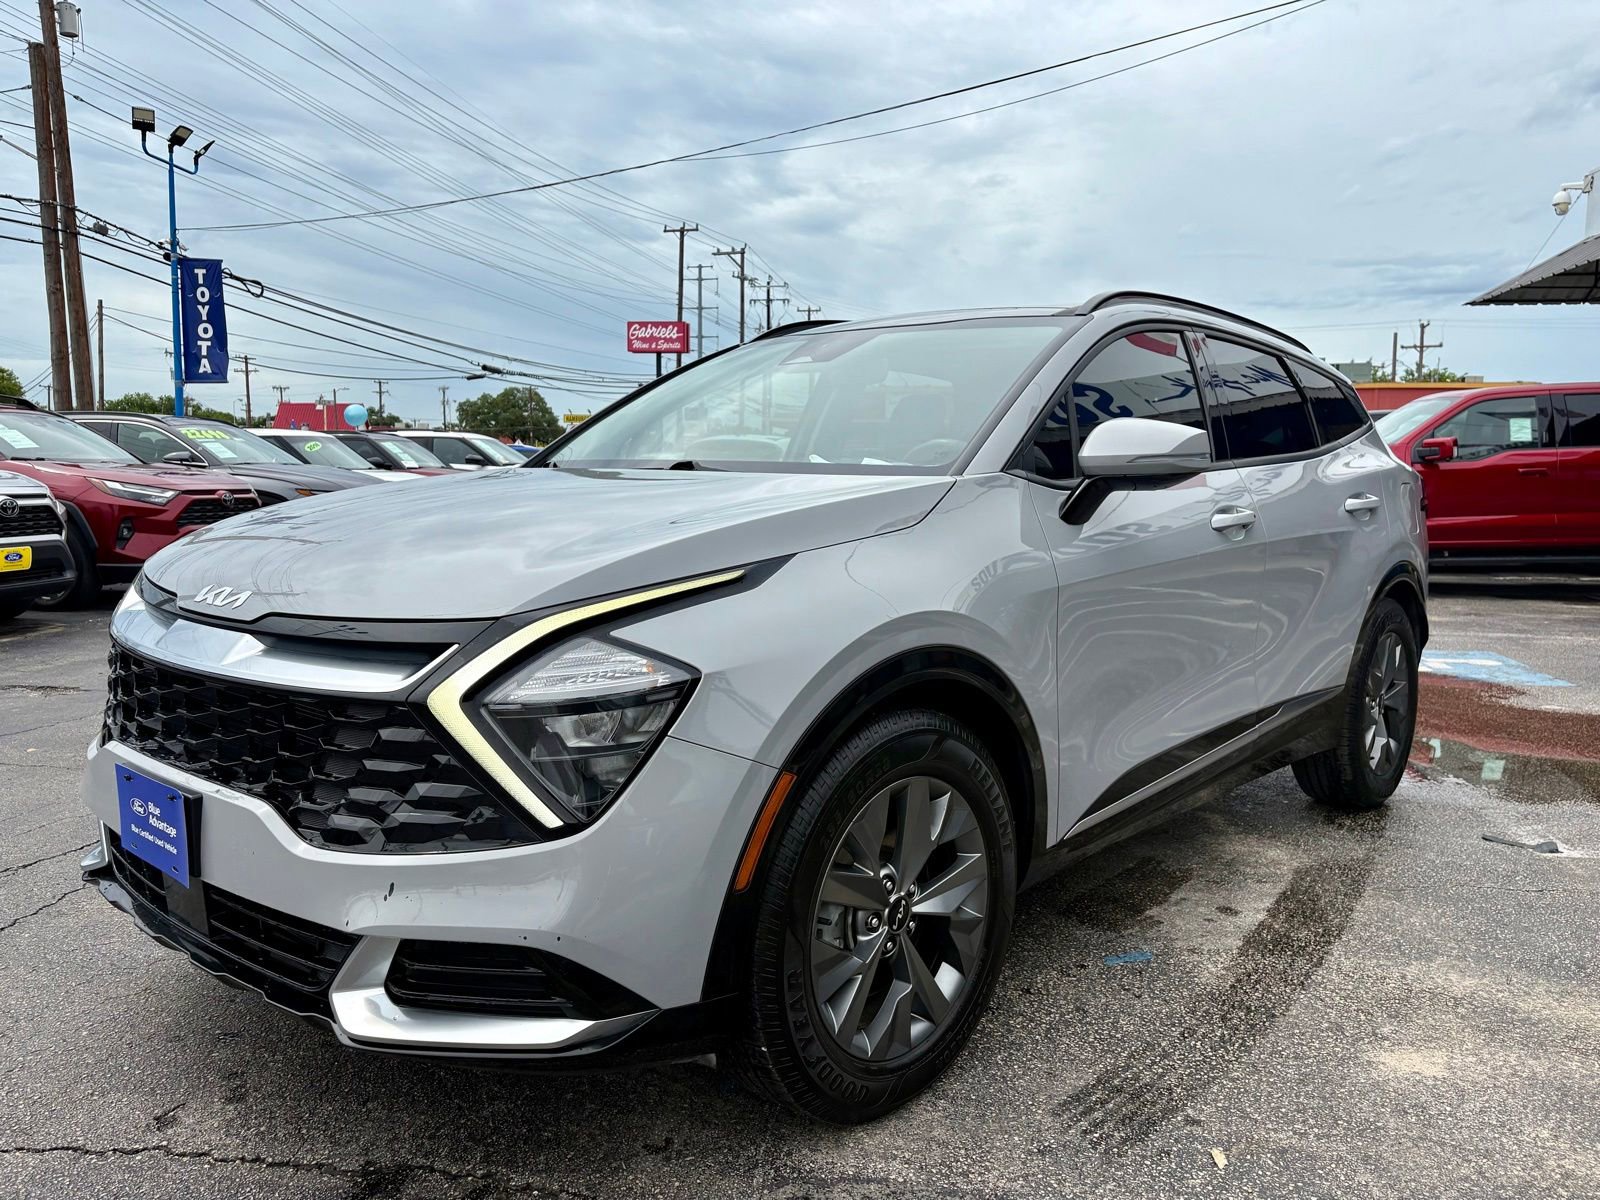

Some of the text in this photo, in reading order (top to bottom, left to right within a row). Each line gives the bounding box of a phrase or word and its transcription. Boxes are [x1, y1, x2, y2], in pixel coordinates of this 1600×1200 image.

[193, 268, 213, 373] TOYOTA
[629, 323, 683, 339] Gabriels
[632, 340, 650, 349] Wine
[657, 340, 681, 350] Spirits
[148, 801, 161, 816] Blue
[148, 814, 177, 838] Advantage
[131, 824, 178, 855] Blue Certified Used Vehicle
[785, 967, 870, 1103] GOODYEAR
